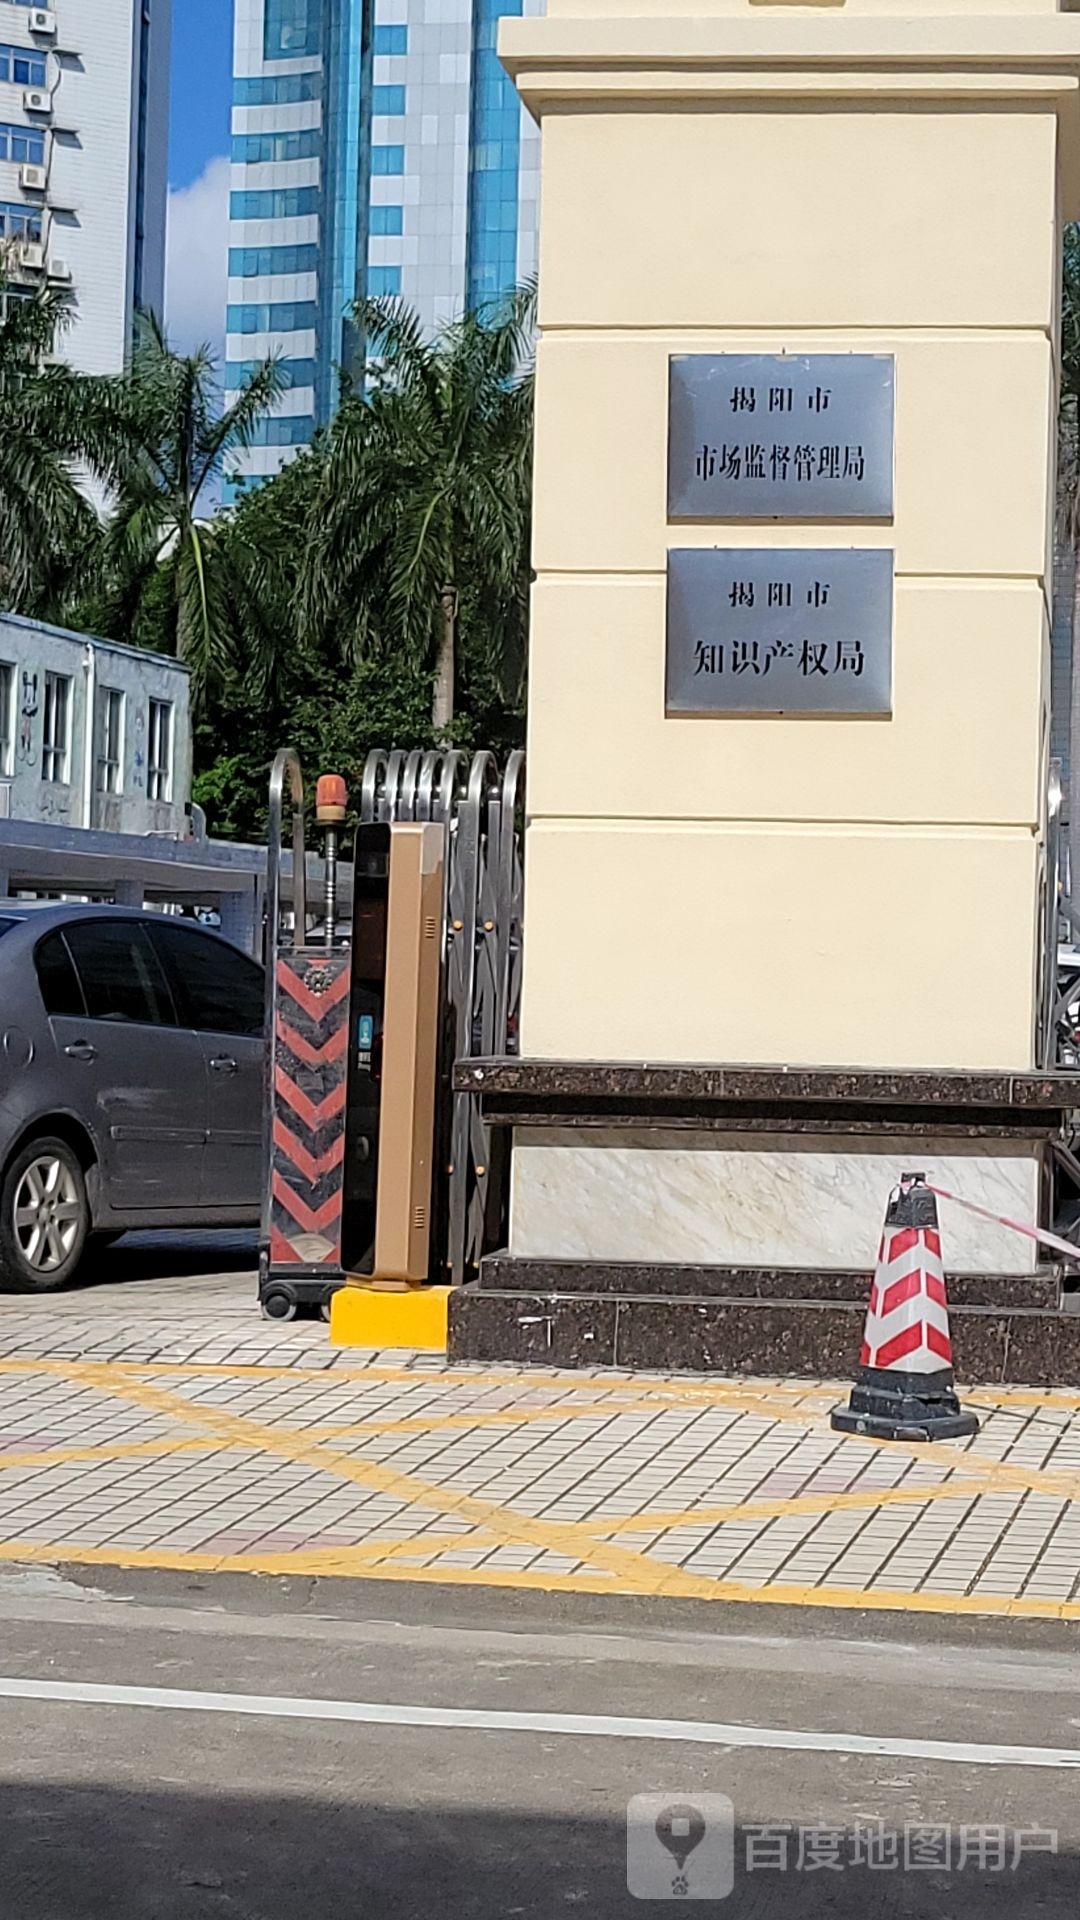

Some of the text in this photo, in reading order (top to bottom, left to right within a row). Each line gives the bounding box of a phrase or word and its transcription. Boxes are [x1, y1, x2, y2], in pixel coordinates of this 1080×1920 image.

[730, 386, 832, 413] 揭阳市
[696, 444, 865, 481] 市场监督管理局
[728, 581, 831, 608] 揭阳市
[693, 639, 865, 677] 知识产权局
